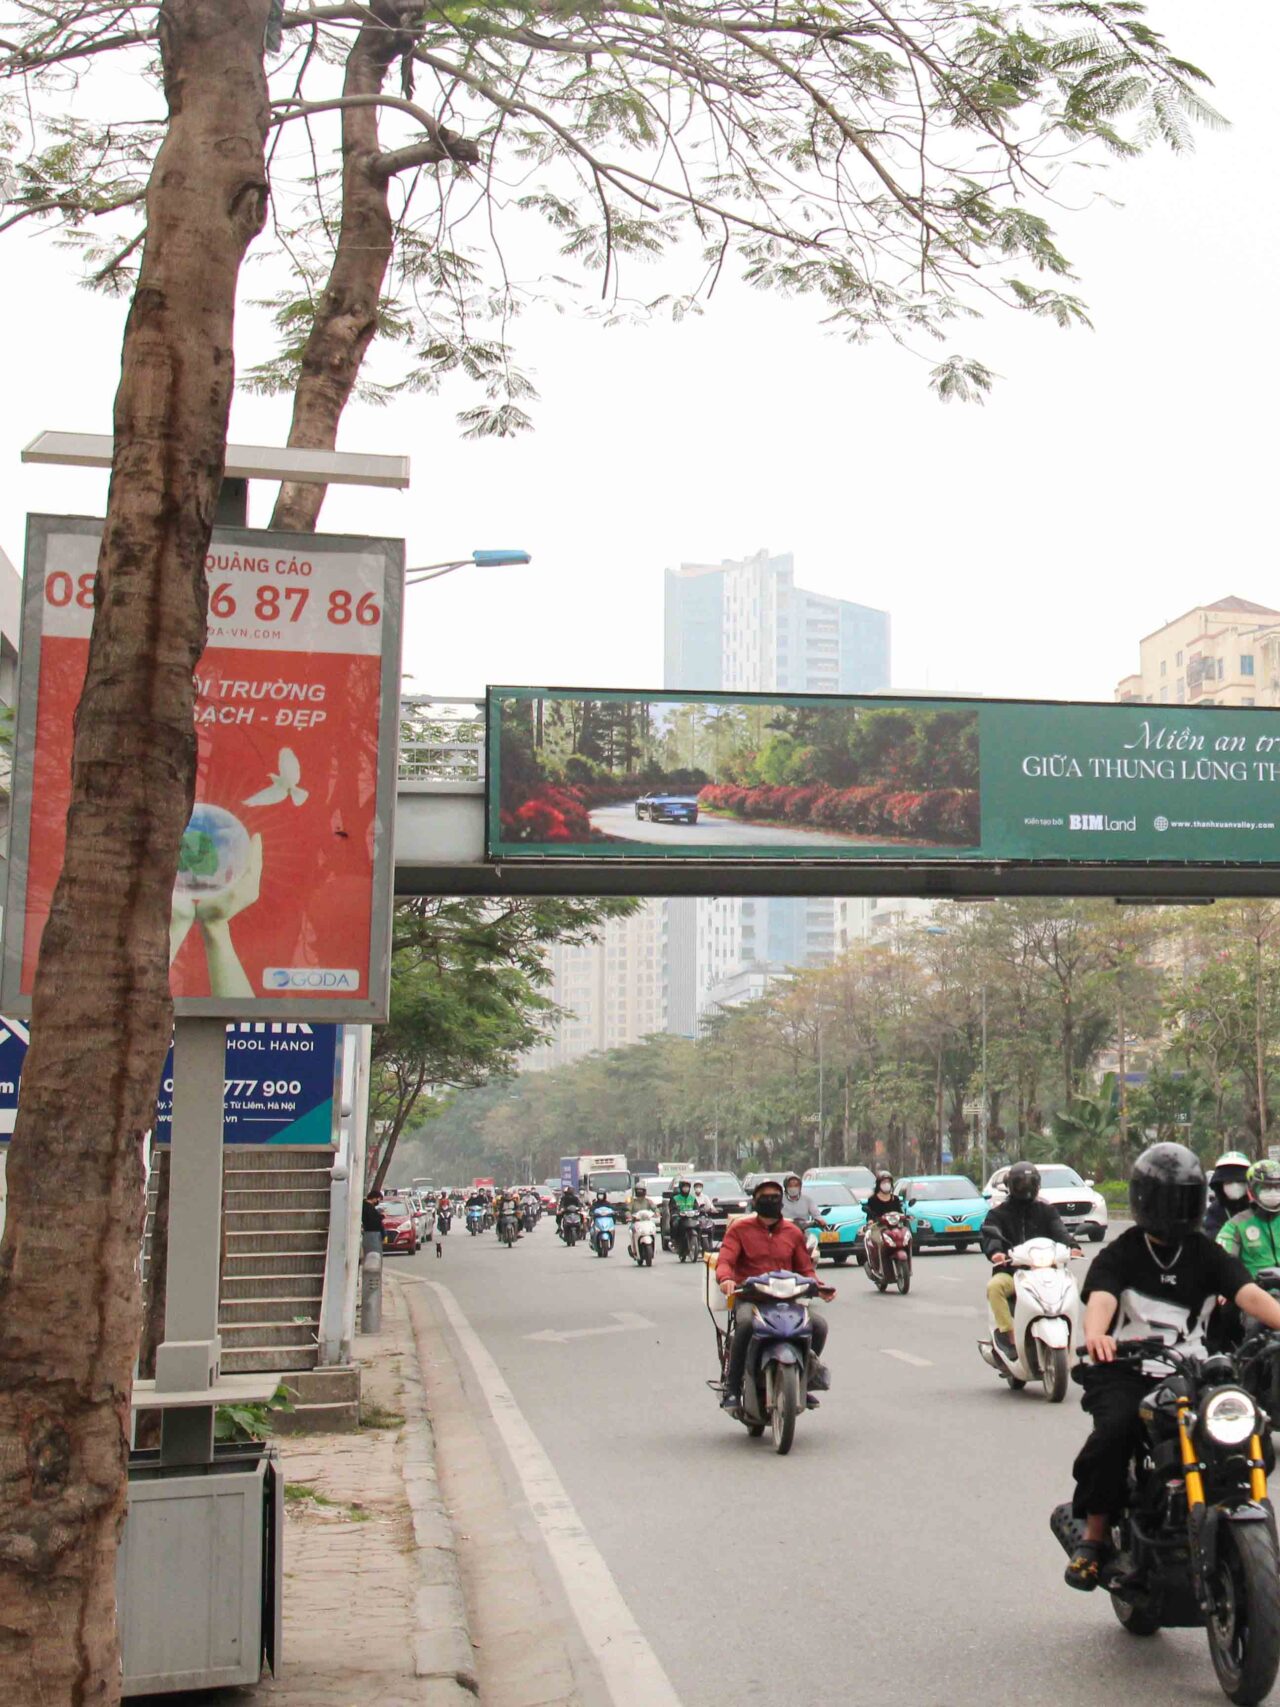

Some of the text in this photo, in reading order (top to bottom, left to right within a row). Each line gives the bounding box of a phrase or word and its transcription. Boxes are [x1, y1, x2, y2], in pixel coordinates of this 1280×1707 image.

[275, 556, 312, 576] CÁO
[254, 585, 310, 622] 87
[327, 589, 381, 626] 86
[219, 678, 326, 701] TRƯỜNG
[275, 709, 327, 731] ĐẸP
[1123, 721, 1206, 751] Miền
[1214, 735, 1246, 751] an
[1022, 754, 1083, 777] GIỮA
[1089, 758, 1175, 780] THUNG
[1181, 758, 1247, 781] LŨNG
[291, 972, 350, 987] GODA
[226, 1039, 314, 1051] HOOL HANOI
[263, 1080, 302, 1096] 900
